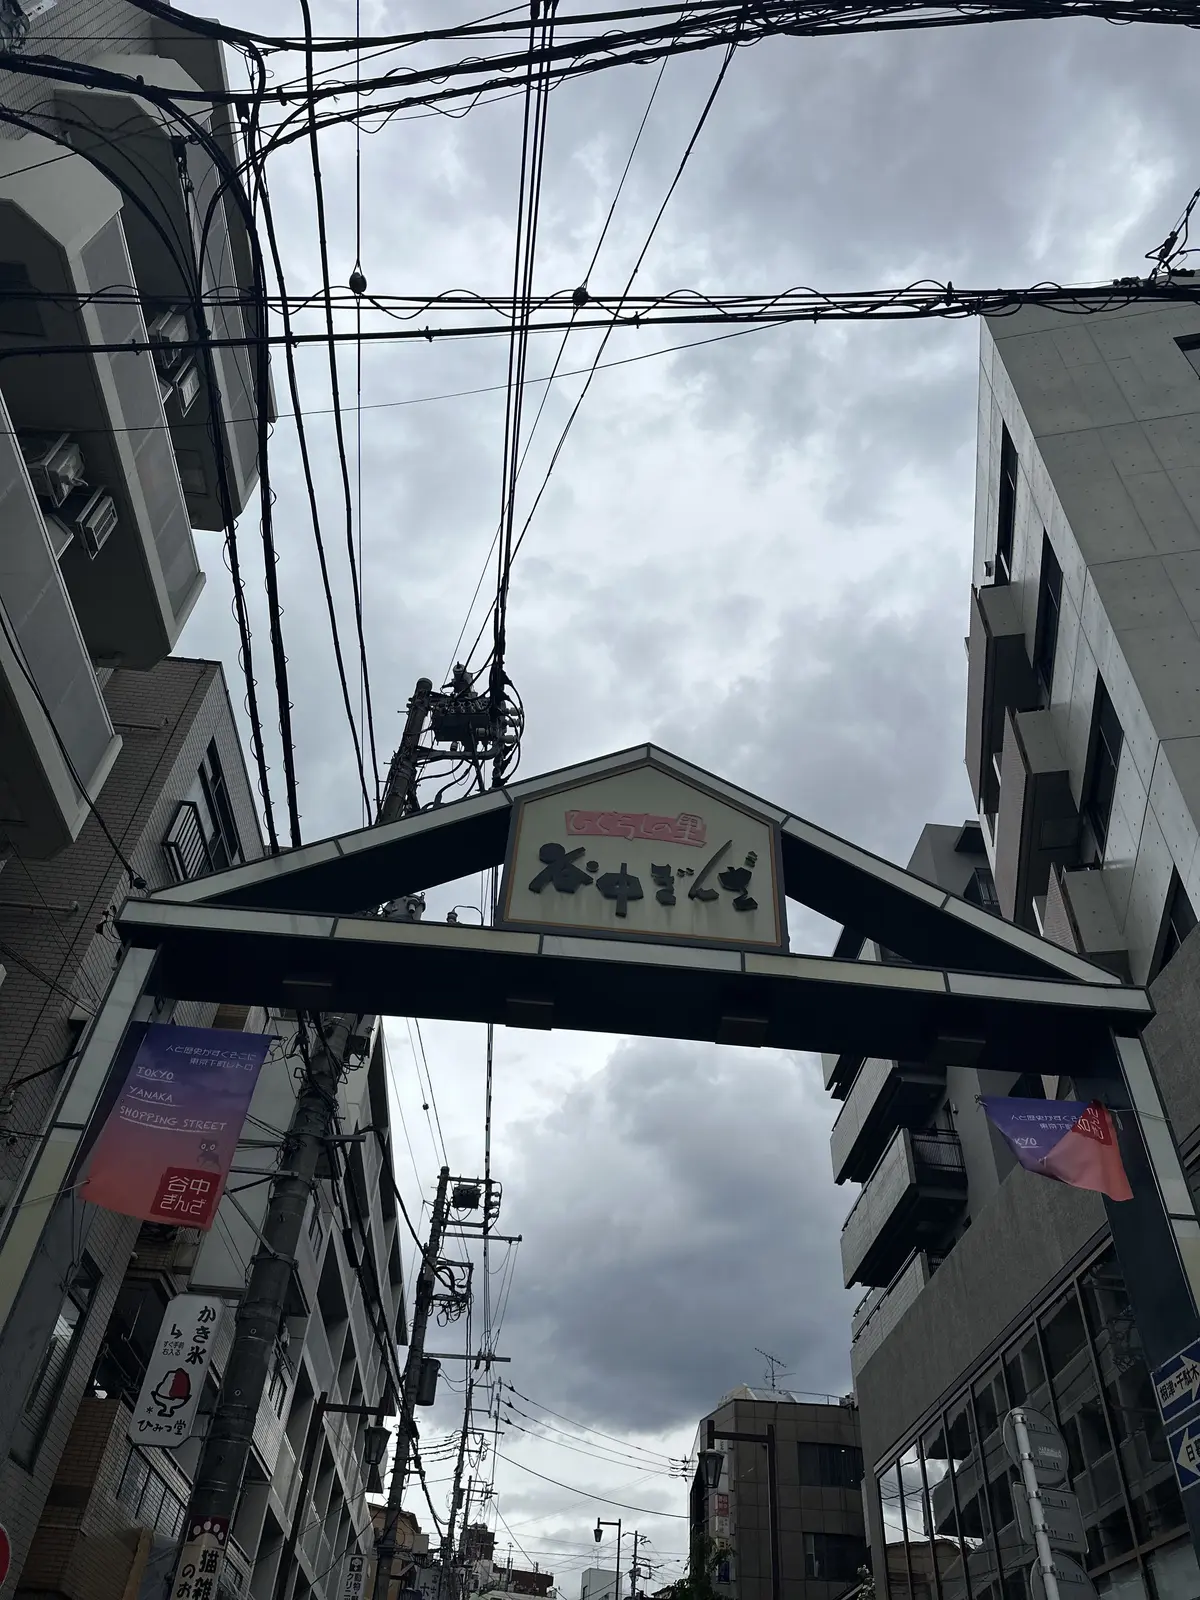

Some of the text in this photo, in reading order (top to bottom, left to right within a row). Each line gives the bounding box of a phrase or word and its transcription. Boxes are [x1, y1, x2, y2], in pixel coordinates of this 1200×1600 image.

[137, 1066, 175, 1081] TOKYO
[129, 1085, 174, 1103] YANAKA
[119, 1105, 227, 1131] SHOPPING STREET
[1012, 1137, 1037, 1146] KYO
[168, 1175, 211, 1195] 谷中
[159, 1194, 207, 1216] ぎんざ
[184, 1305, 217, 1365] かき氷
[137, 1419, 187, 1436] ひみつ堂
